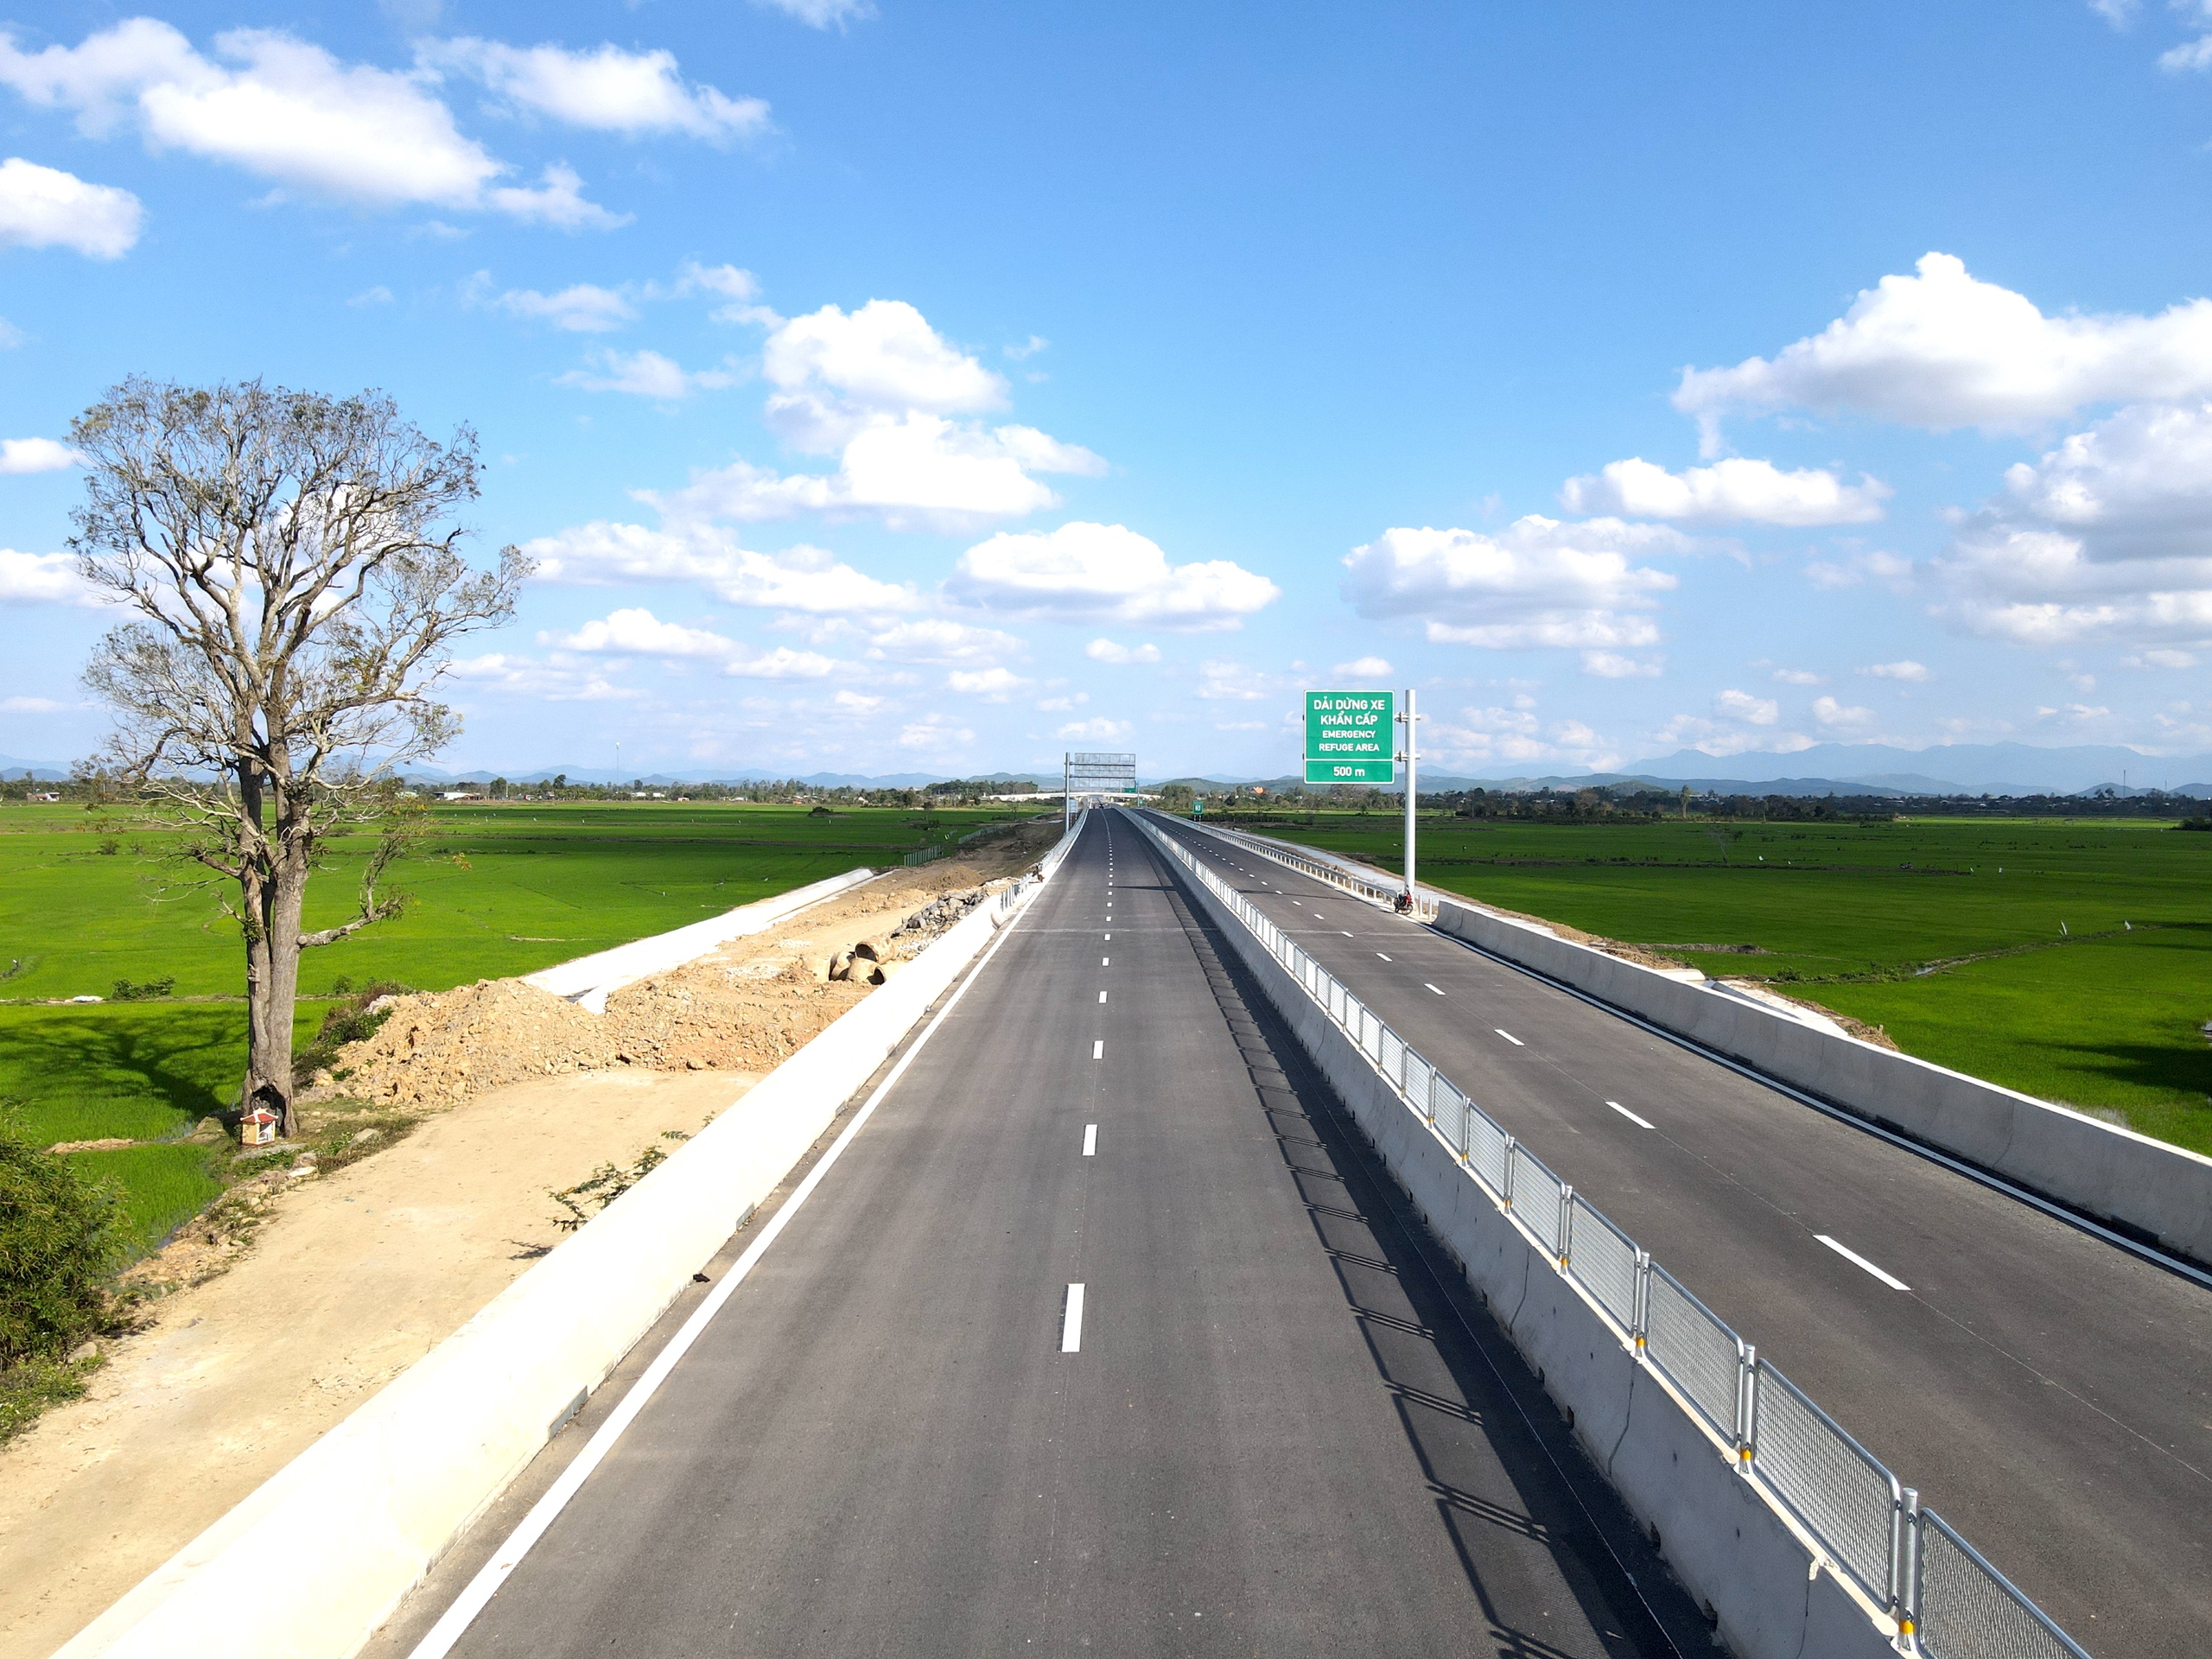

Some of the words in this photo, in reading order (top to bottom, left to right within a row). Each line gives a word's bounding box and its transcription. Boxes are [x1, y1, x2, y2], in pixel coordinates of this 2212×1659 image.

[1313, 696, 1332, 710] DẢI
[1336, 696, 1368, 710] DỪNG
[1370, 700, 1385, 710] XE
[1320, 710, 1352, 725] KHẨN
[1355, 711, 1378, 725] CẤP
[1322, 730, 1376, 739] EMERGENCY
[1319, 743, 1353, 752] REFUGE
[1355, 743, 1380, 752] AREA
[1333, 766, 1352, 777] 500
[1355, 768, 1365, 777] m
